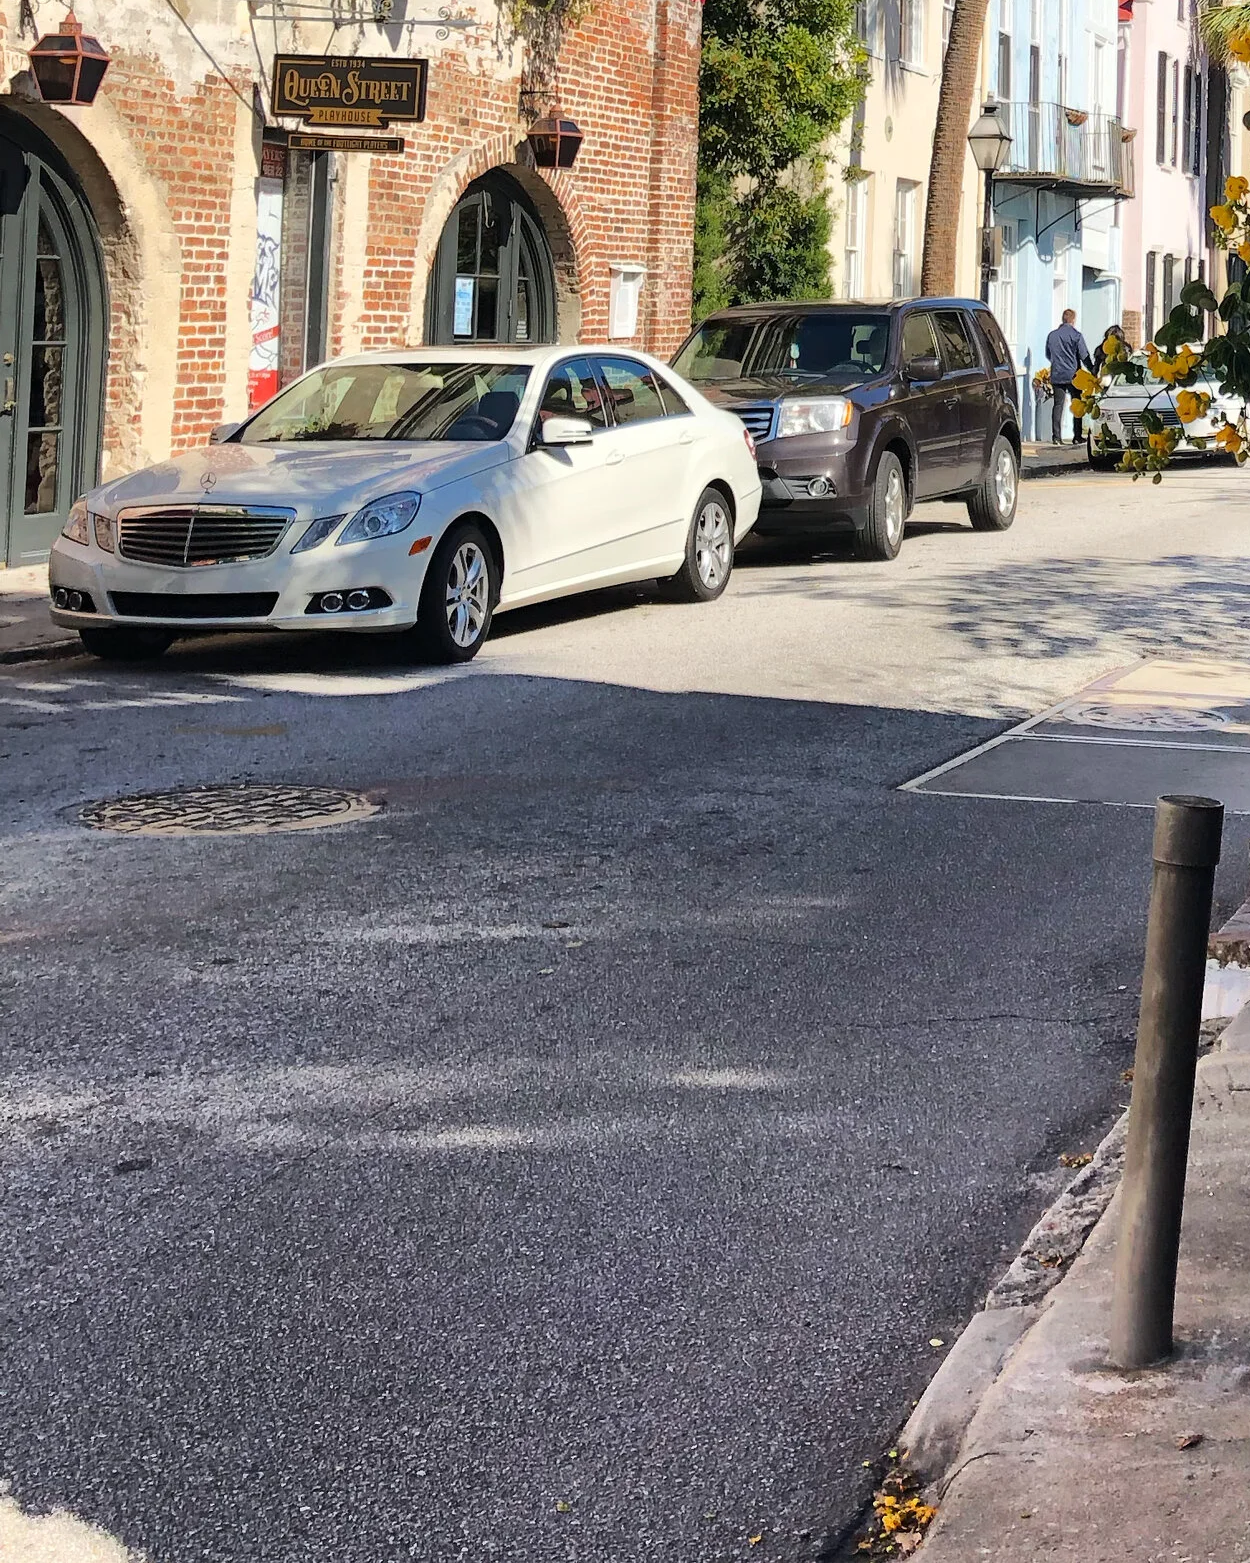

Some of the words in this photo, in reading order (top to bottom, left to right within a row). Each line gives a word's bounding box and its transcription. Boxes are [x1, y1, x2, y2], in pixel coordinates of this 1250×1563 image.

[349, 59, 366, 69] 1934
[284, 69, 341, 106] QUEEN
[341, 70, 412, 105] STREET
[318, 109, 371, 123] PLAYHOUSE
